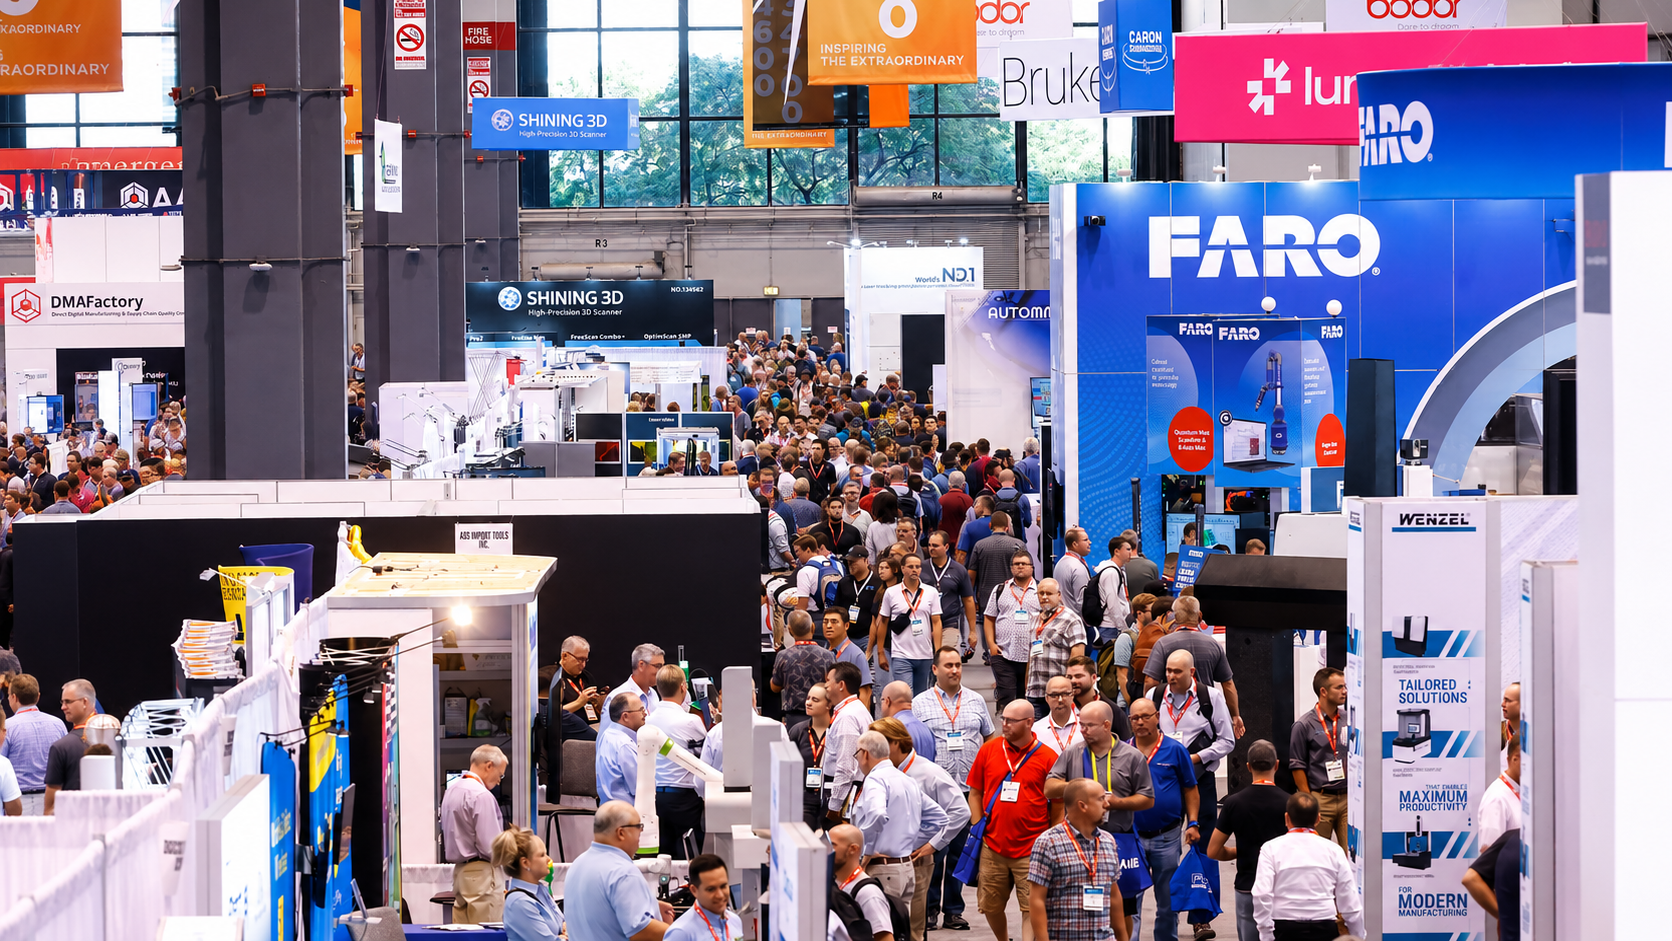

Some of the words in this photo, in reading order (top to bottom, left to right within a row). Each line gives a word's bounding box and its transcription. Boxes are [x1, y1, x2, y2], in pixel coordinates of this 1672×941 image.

[468, 27, 489, 36] FIRE
[1129, 31, 1162, 44] CARON
[465, 36, 492, 44] HOSE
[820, 44, 886, 54] INSPIRING
[820, 56, 846, 66] THE
[850, 55, 964, 66] EXTRAORDINARY
[518, 113, 584, 128] SHINING
[586, 114, 608, 128] 3D
[932, 192, 942, 200] R4
[1149, 214, 1380, 278] FARO
[51, 296, 144, 312] DMAFactory
[527, 290, 598, 306] SHINING
[601, 290, 624, 305] 3D
[582, 308, 592, 316] 3D
[594, 308, 622, 316] Scanner
[1179, 322, 1212, 336] FARO
[1218, 327, 1260, 340] FARO
[1321, 325, 1344, 338] FARO
[1400, 513, 1469, 526] WENZEL
[492, 531, 509, 540] TOOLS
[479, 540, 490, 548] INC.
[1399, 679, 1456, 690] TAILORED
[1399, 692, 1468, 704] SOLUTIONS
[1400, 790, 1468, 802] MAXIMUM
[1400, 803, 1468, 811] PRODUCTIVITY
[1399, 894, 1468, 908] MODERN
[1399, 909, 1468, 917] MANUFACTURING
